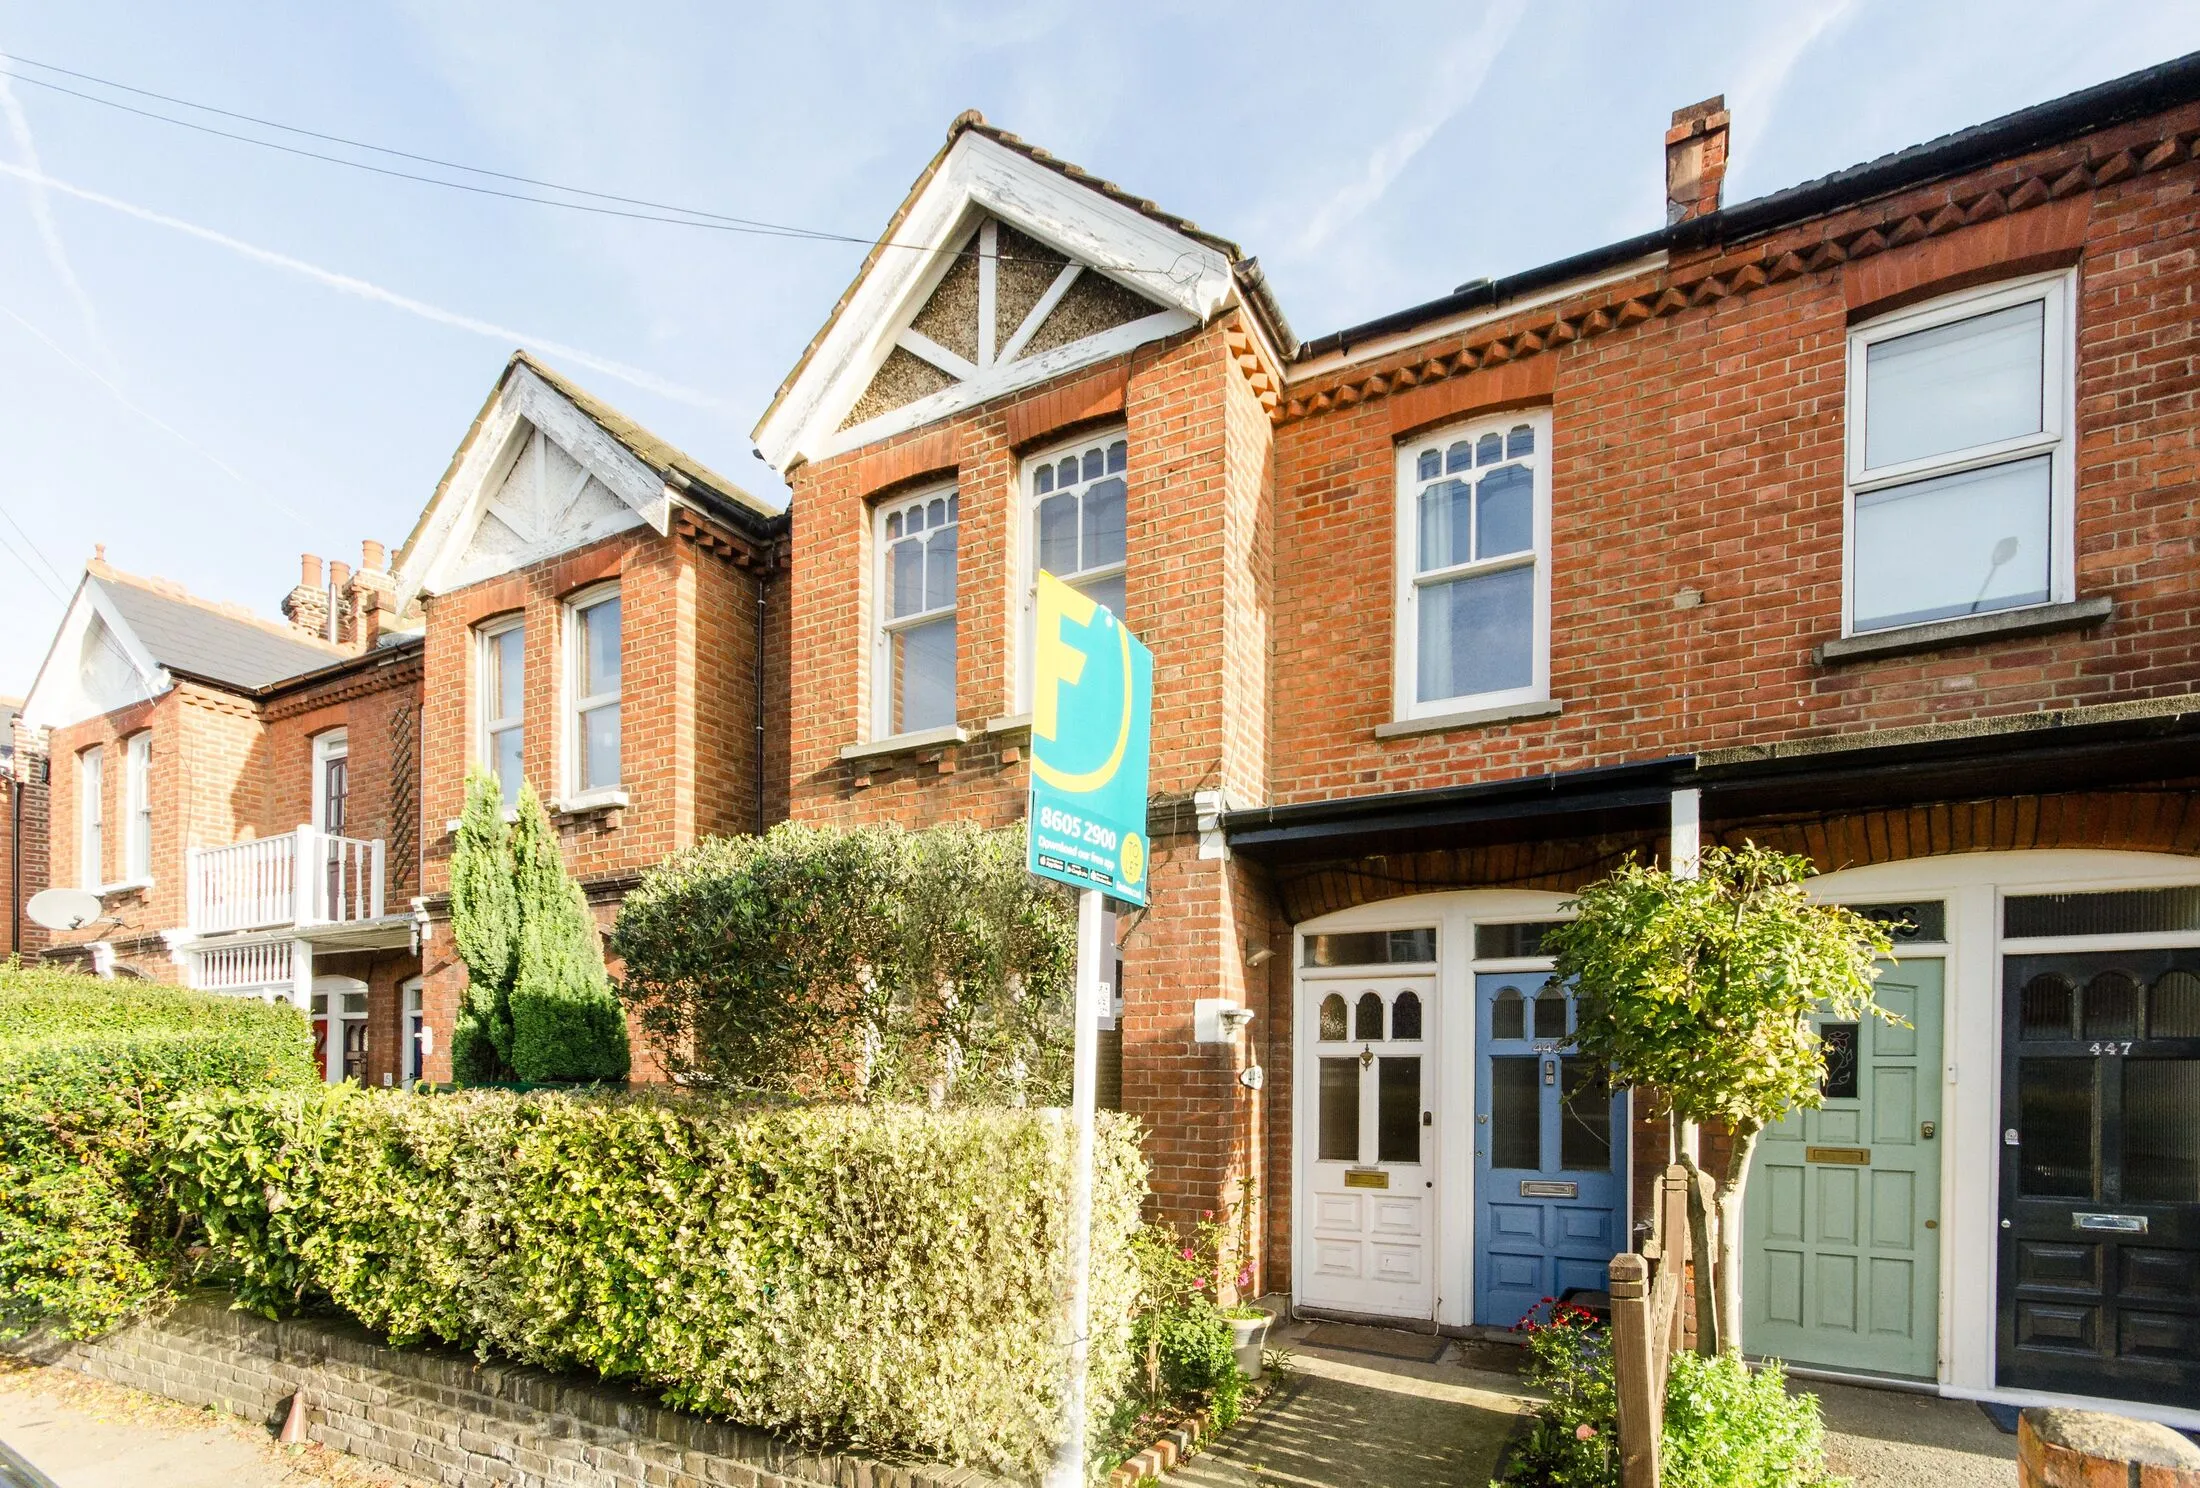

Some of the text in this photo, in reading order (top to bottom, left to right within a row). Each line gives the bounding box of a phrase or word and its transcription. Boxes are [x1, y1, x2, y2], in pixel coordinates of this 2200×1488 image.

[1041, 806, 1116, 850] 8605 2900
[2089, 1042, 2133, 1056] 447
